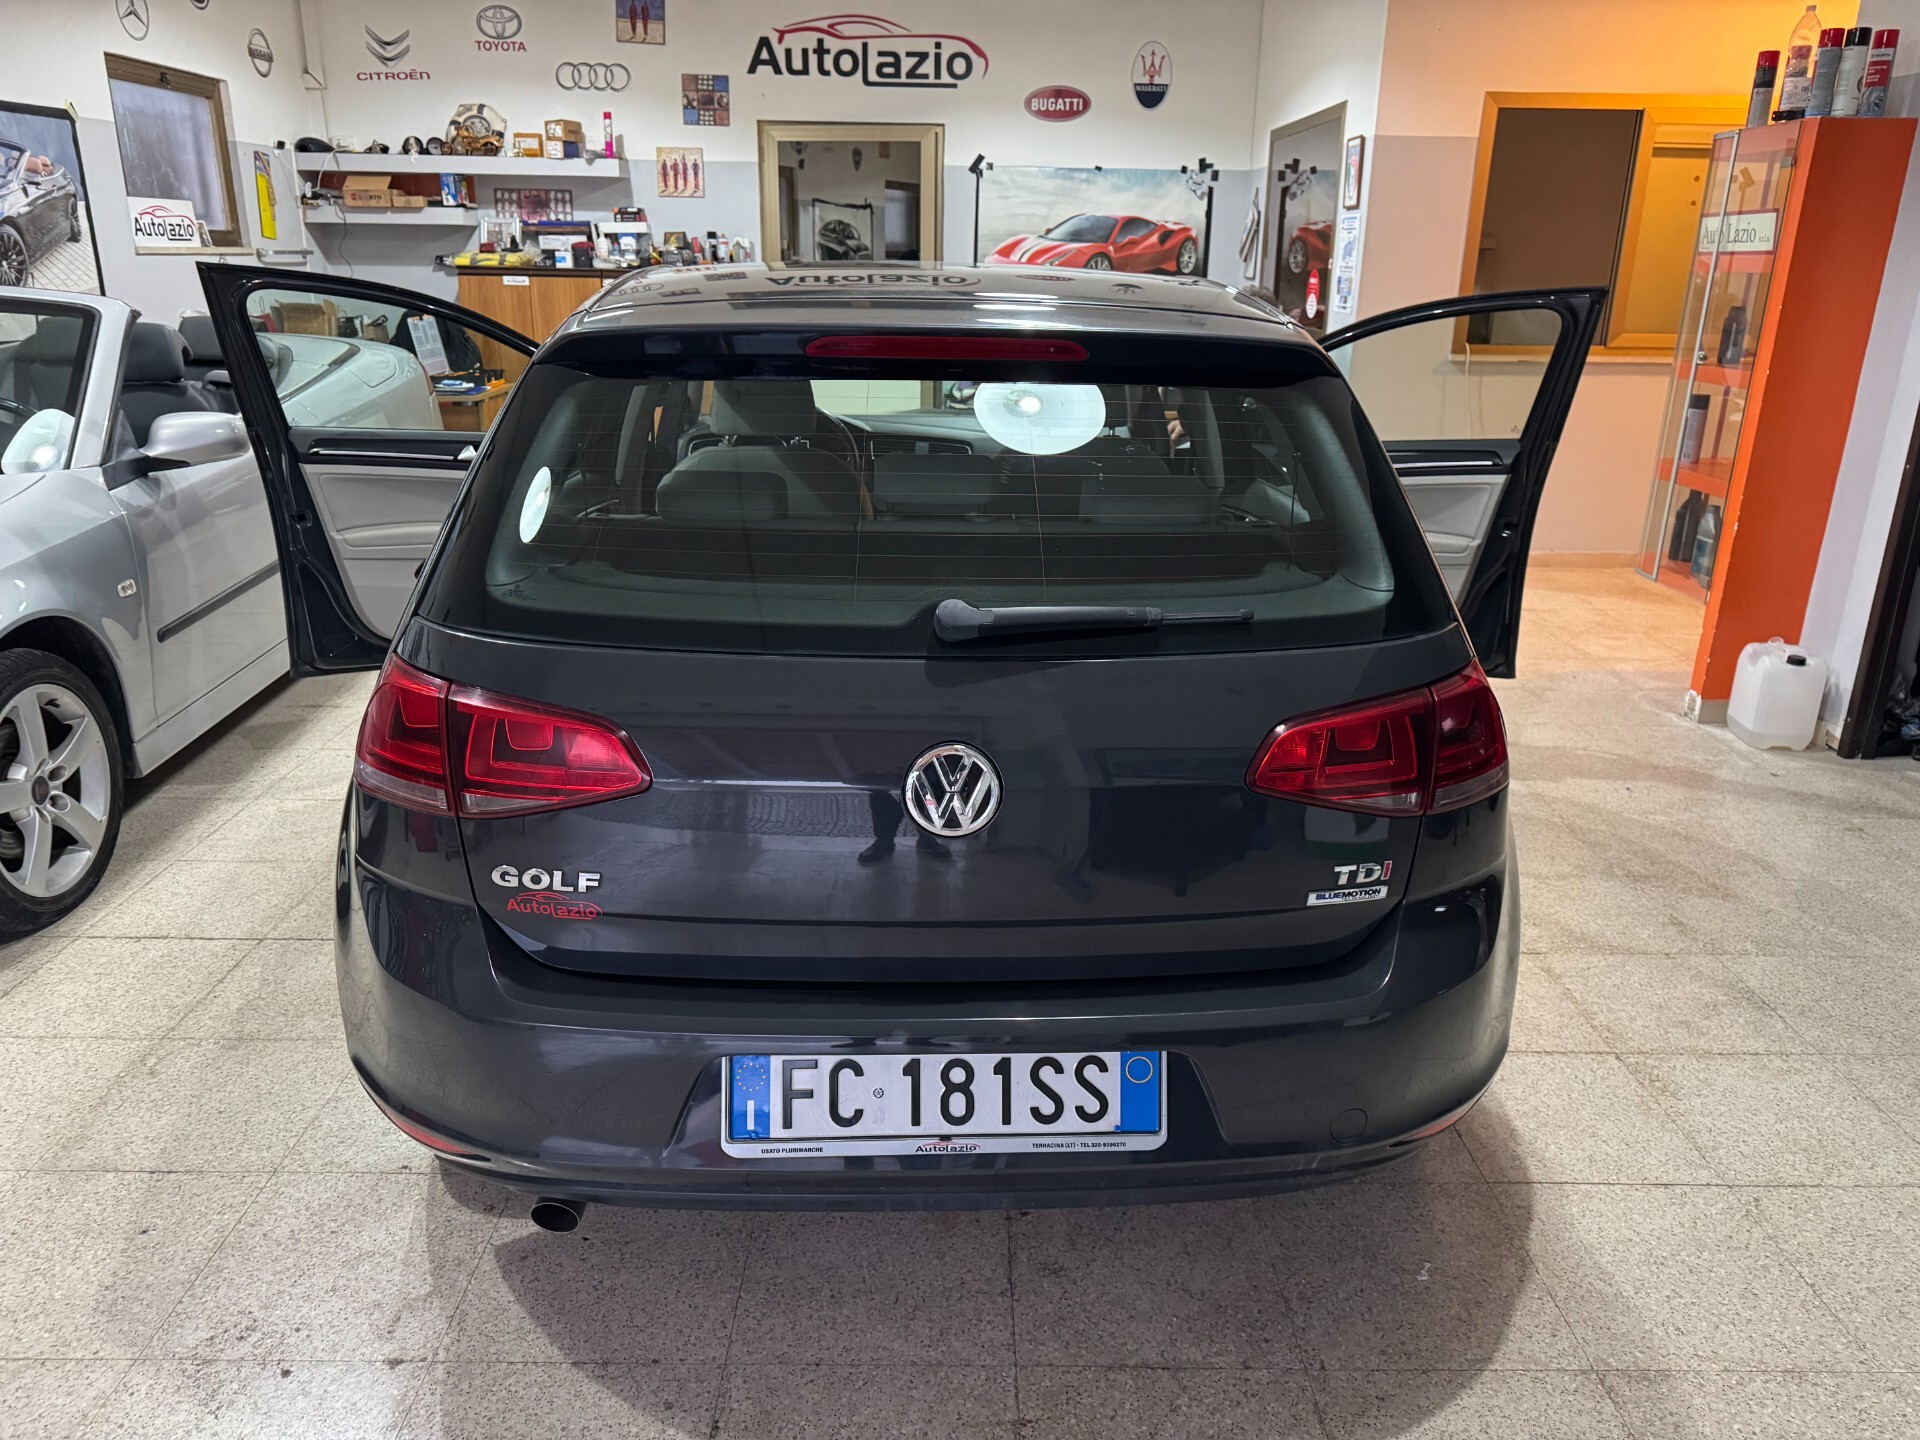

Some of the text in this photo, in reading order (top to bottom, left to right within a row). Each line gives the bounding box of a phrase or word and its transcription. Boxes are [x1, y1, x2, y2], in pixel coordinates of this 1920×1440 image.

[475, 40, 527, 52] TOYOTA
[1135, 84, 1168, 92] MASERATI
[1031, 98, 1083, 111] BUGATTI
[1726, 221, 1757, 244] Lazio
[491, 864, 601, 893] GOLF
[1334, 860, 1392, 885] TDI
[1315, 888, 1382, 901] BLUEMOTION
[782, 1058, 865, 1130] FC
[746, 1100, 755, 1130] I
